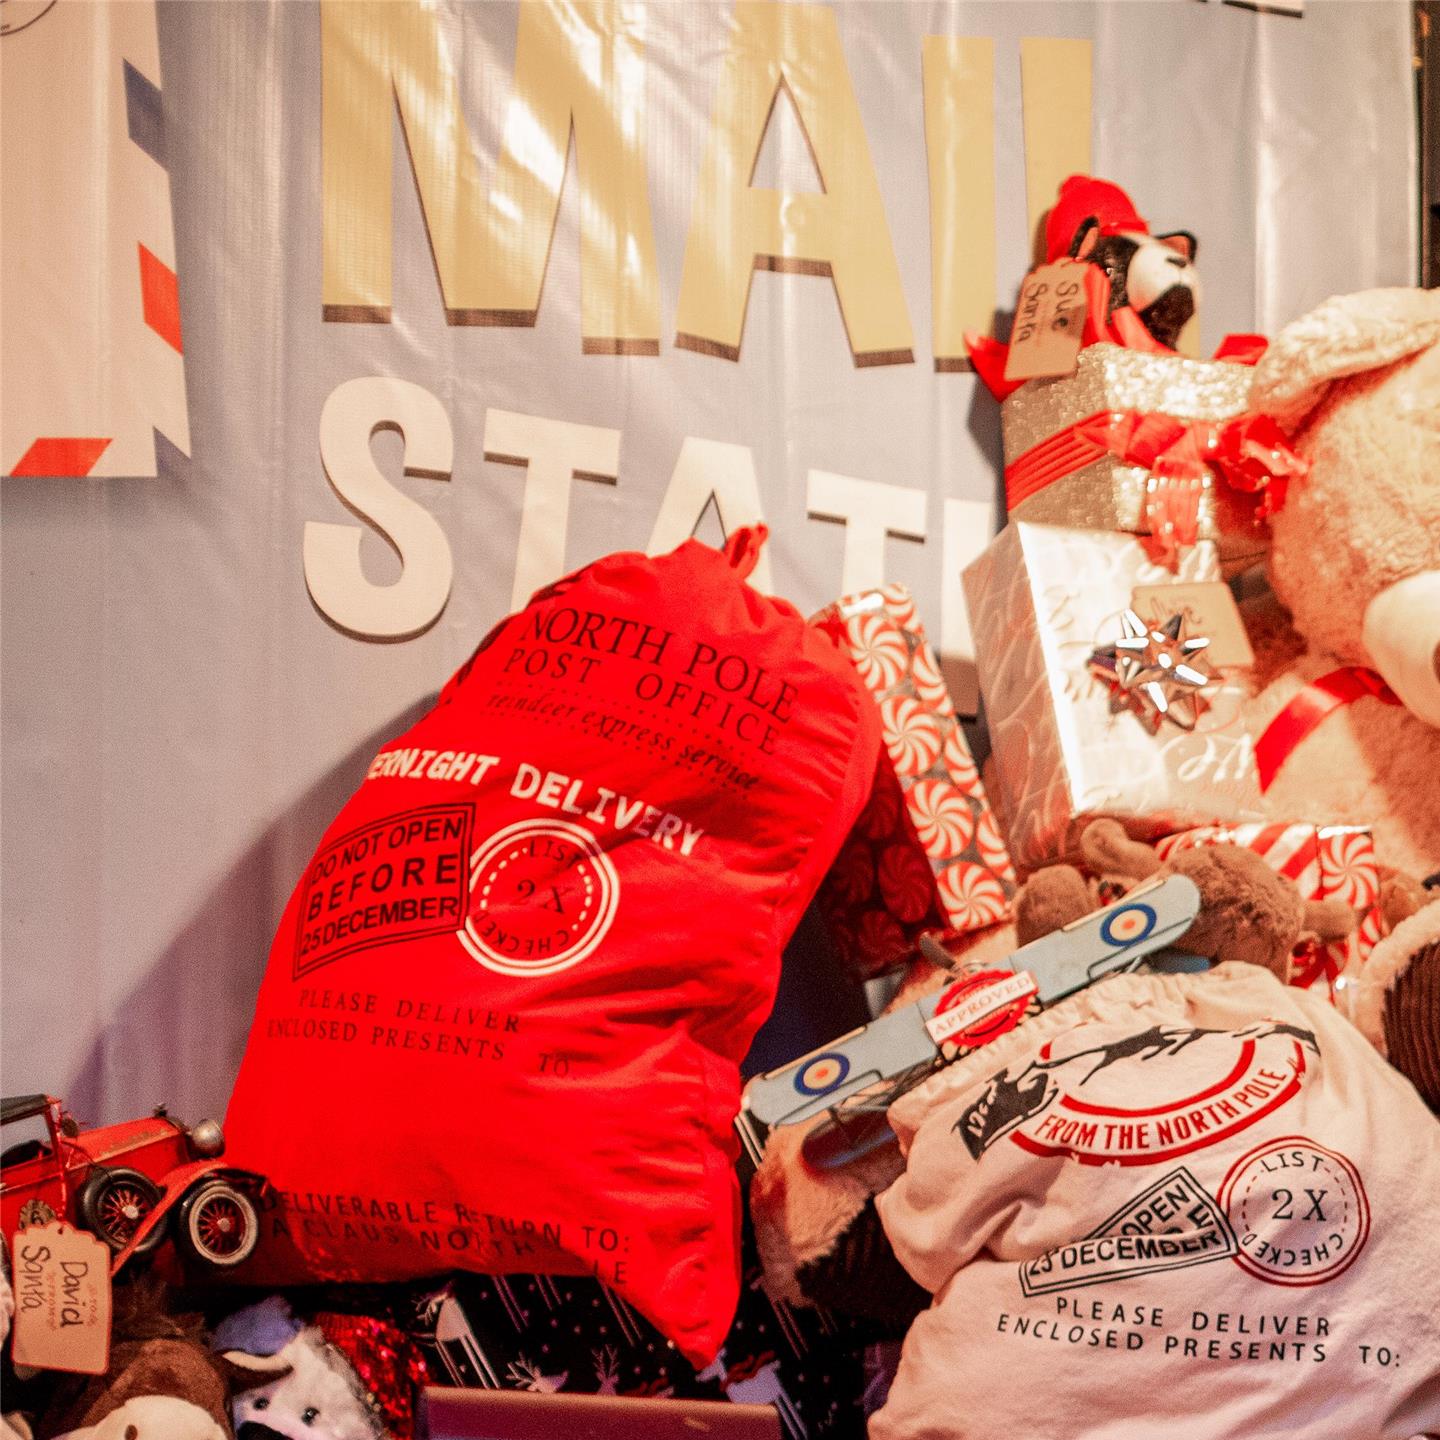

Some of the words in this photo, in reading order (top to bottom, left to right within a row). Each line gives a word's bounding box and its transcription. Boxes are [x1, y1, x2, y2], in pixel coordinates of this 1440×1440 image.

[1014, 282, 1048, 342] Santa
[1051, 280, 1079, 332] Sue
[518, 607, 673, 667] NORTH
[682, 642, 799, 724] POLE
[503, 648, 602, 684] POST
[634, 673, 781, 756] OFFICE
[510, 762, 705, 858] DELIVERY
[311, 852, 338, 886] DO
[341, 831, 385, 872] NOT
[389, 816, 464, 850] OPEN
[307, 853, 459, 922] BEFORE
[322, 896, 459, 947] DECEMBER
[266, 1017, 358, 1042] ENCLOSED
[371, 1026, 505, 1060] PRESENTS
[299, 989, 380, 1014] PLEASE
[395, 999, 521, 1034] DELIVER
[1034, 1115, 1099, 1148] FROM
[1104, 1122, 1150, 1151] THE
[1157, 1099, 1241, 1147] NORTH
[1235, 1066, 1287, 1109] POLE
[1261, 1150, 1325, 1173] LIST
[1060, 1229, 1222, 1269] DECEMBER
[1241, 1232, 1344, 1268] CHECKED
[20, 1245, 51, 1313] Santa
[60, 1261, 89, 1329] David
[997, 1313, 1145, 1352] ENCLOSED
[1165, 1335, 1327, 1363] PRESENTS
[1358, 1346, 1401, 1368] TO:
[1056, 1297, 1165, 1328] PLEASE
[1192, 1311, 1331, 1337] DELIVER
